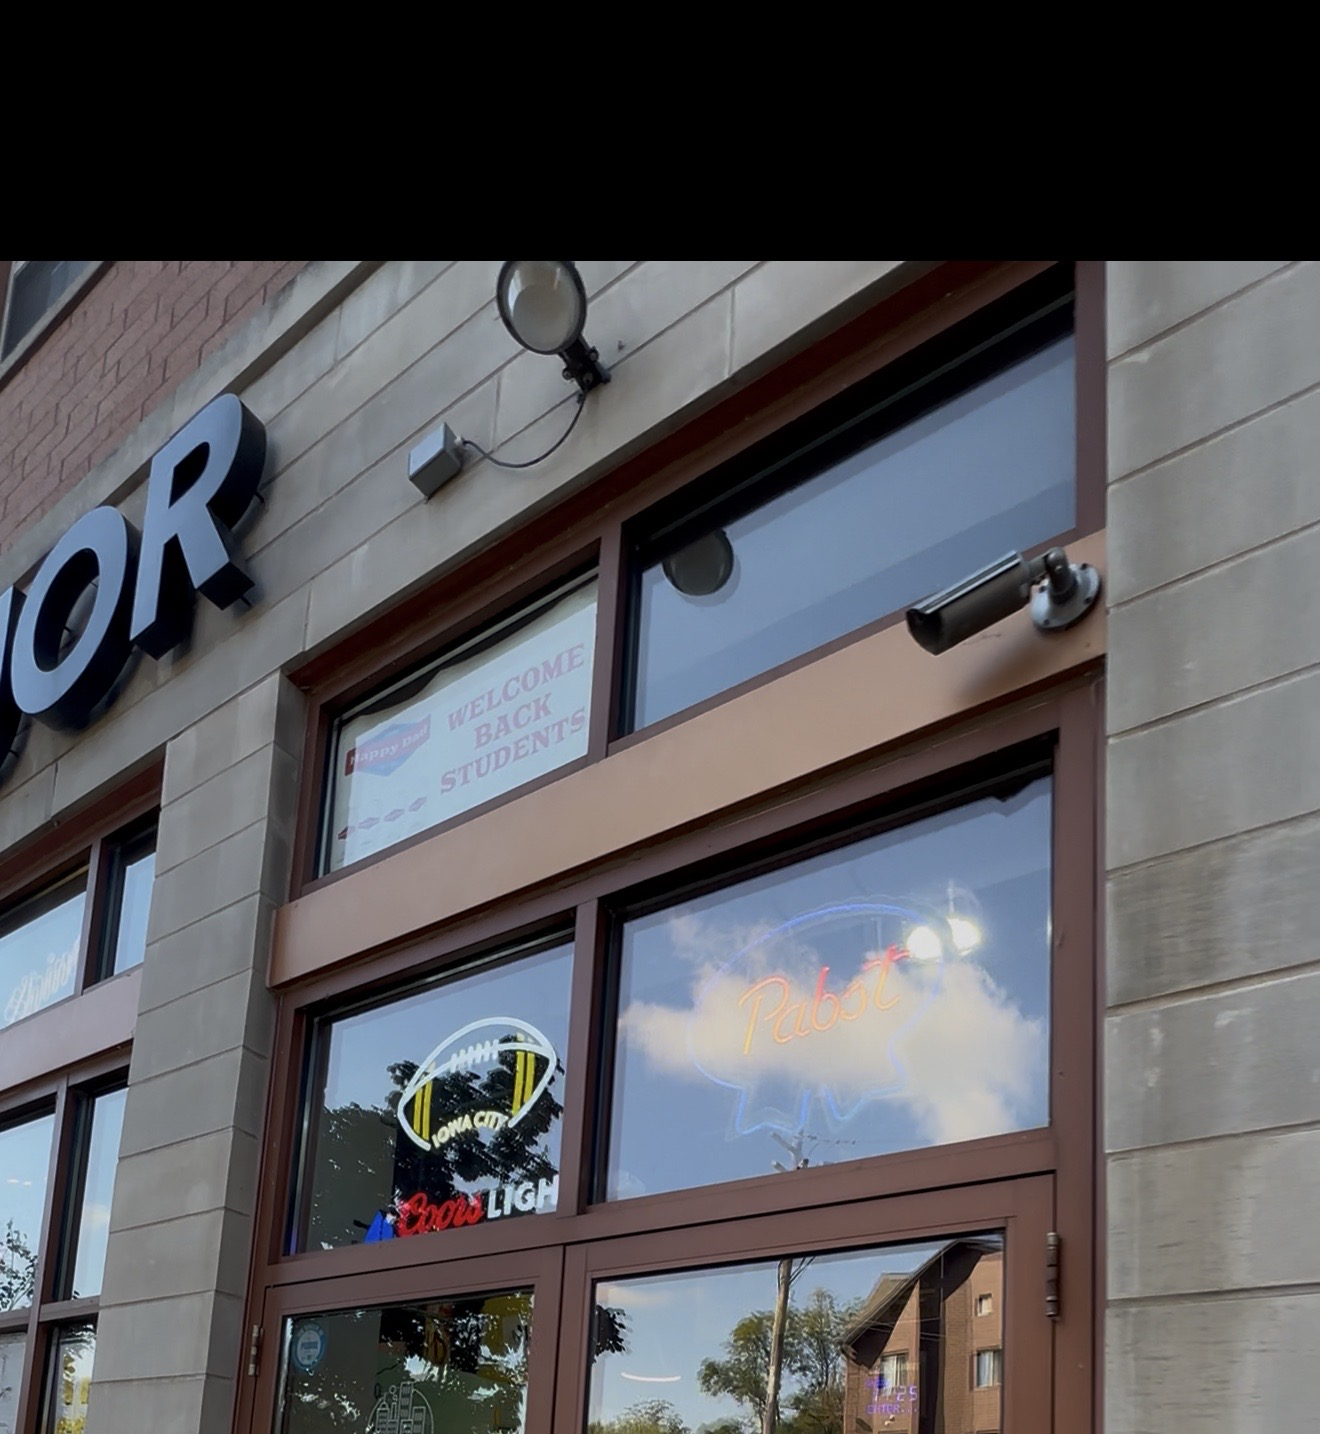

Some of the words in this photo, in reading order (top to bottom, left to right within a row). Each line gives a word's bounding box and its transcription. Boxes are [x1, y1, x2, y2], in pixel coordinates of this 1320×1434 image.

[0, 393, 250, 717] OR
[447, 643, 585, 731] WELCOME
[474, 693, 552, 749] BACK
[350, 743, 399, 765] Happy
[403, 727, 429, 749] Dad
[440, 707, 586, 795] STUDENTS
[738, 943, 910, 1055] Pabst
[431, 1115, 473, 1148] IOWA
[473, 1110, 509, 1131] CITY
[395, 1191, 484, 1238] Coors
